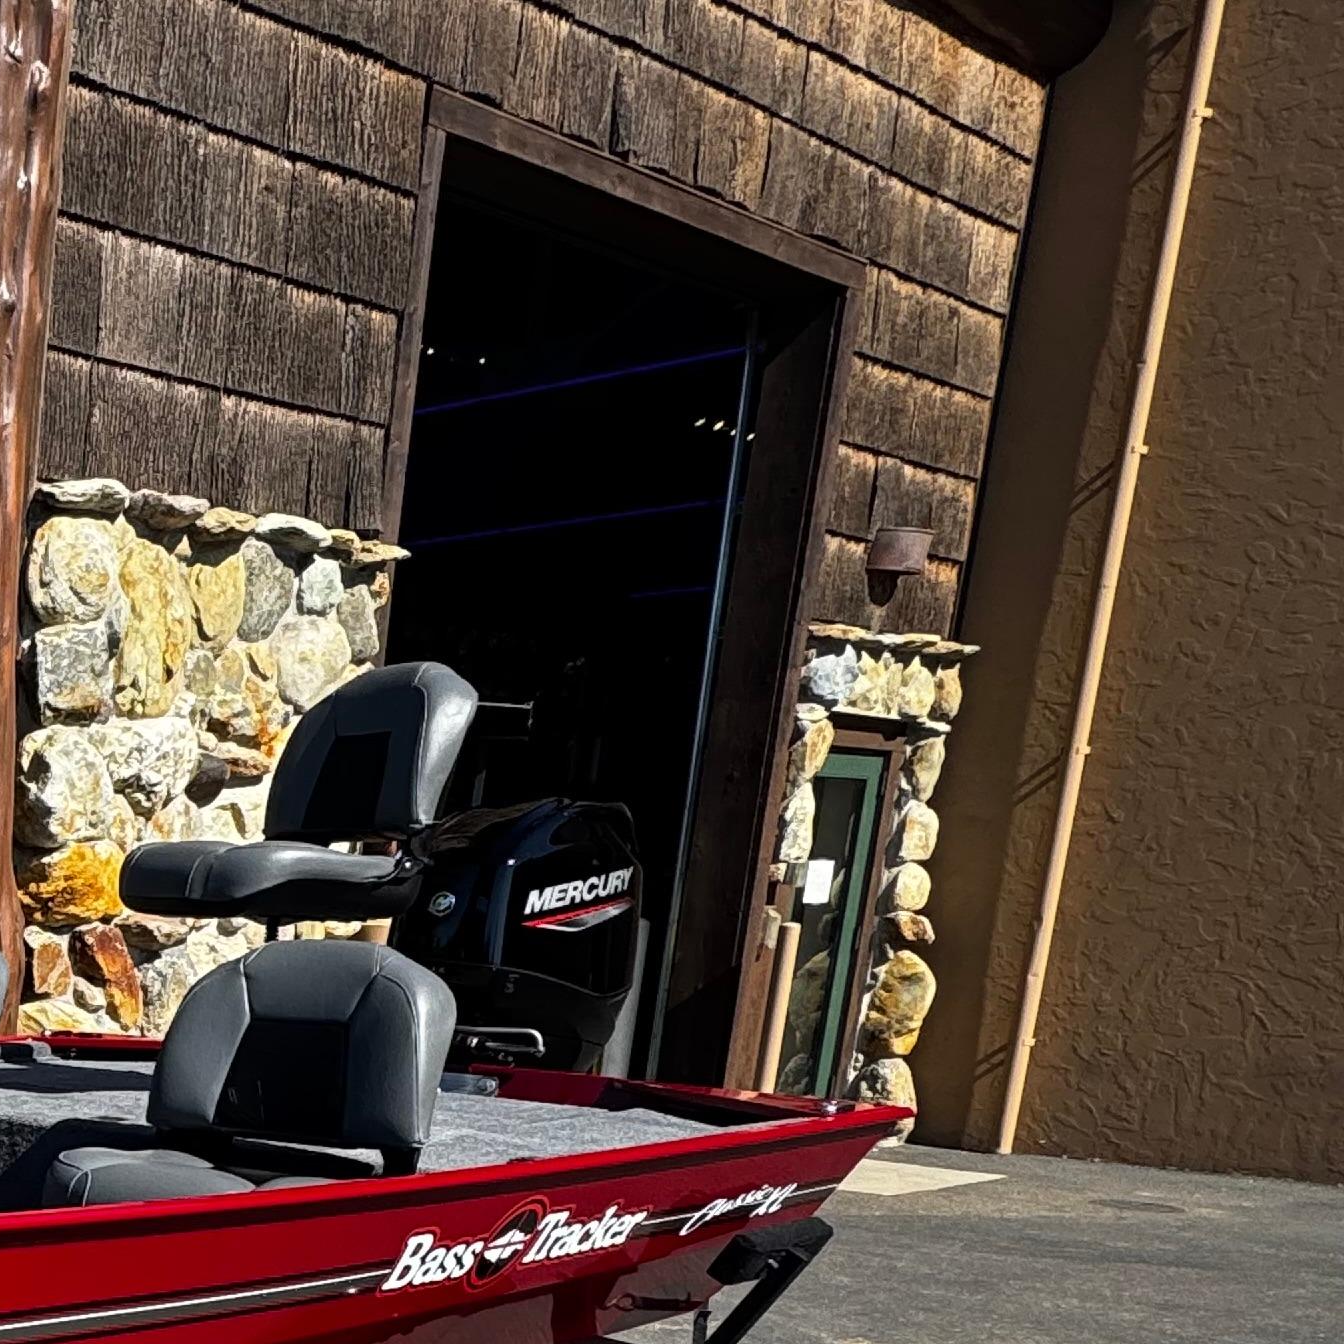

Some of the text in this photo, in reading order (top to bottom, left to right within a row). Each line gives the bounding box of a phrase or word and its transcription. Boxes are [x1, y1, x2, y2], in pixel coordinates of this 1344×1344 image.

[523, 866, 634, 915] MERCURY
[381, 1207, 648, 1291] Bass Tracker
